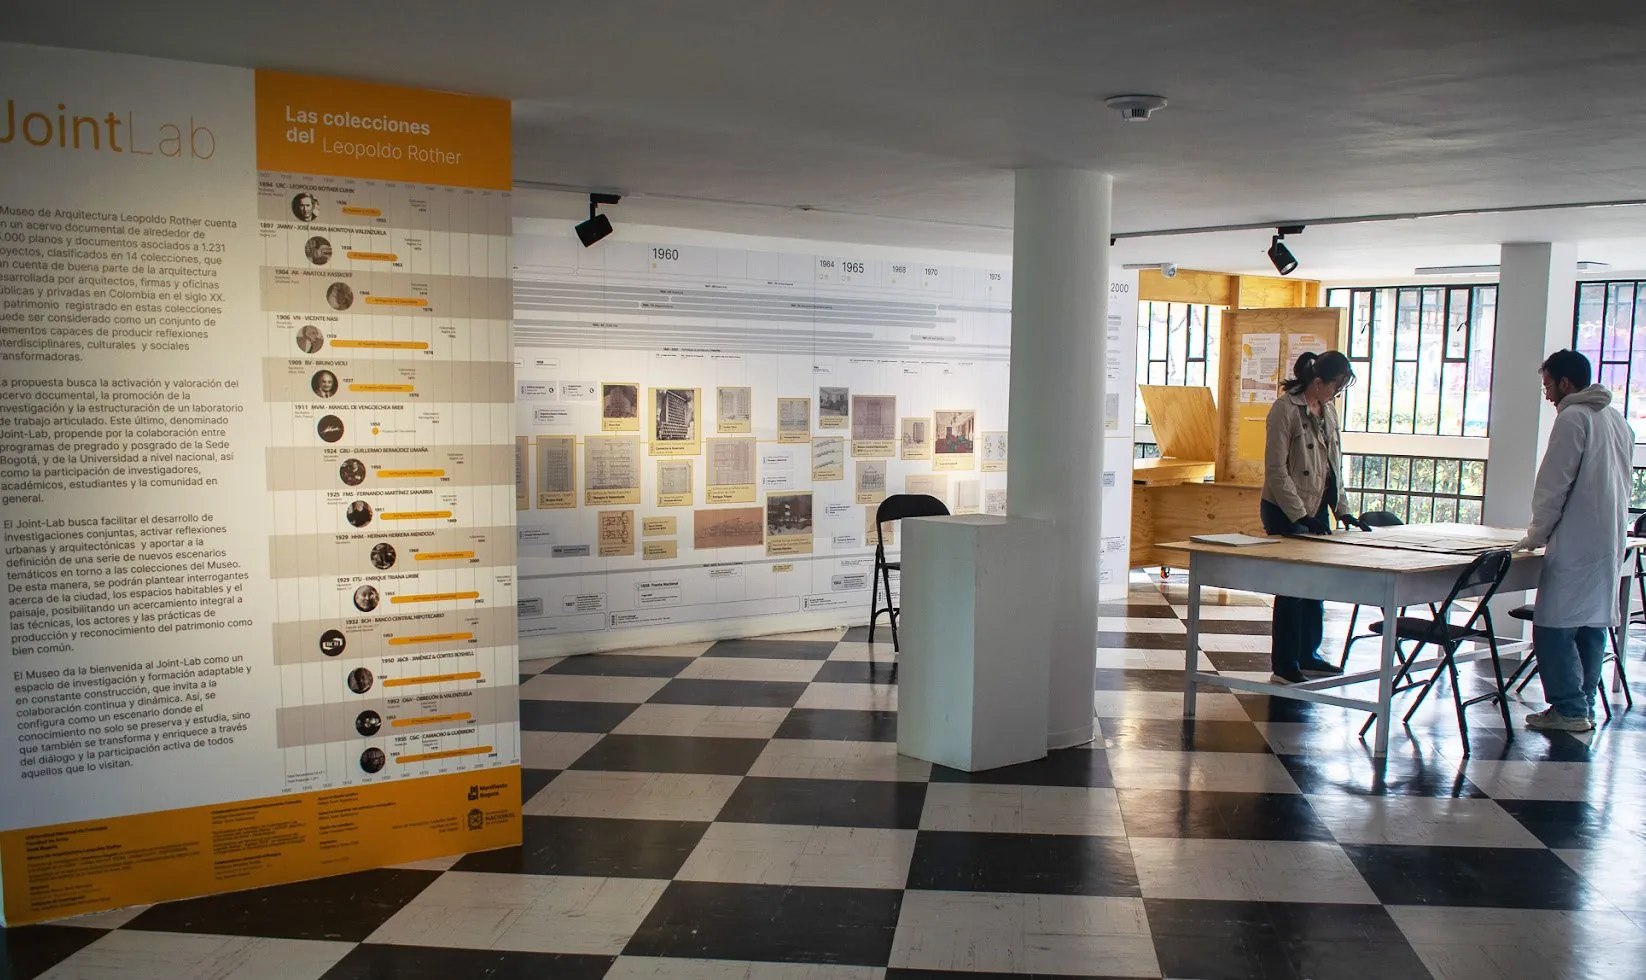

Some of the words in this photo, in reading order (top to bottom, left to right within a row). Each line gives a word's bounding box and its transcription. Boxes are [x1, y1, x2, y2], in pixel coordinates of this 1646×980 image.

[286, 105, 318, 124] Las
[323, 111, 430, 136] colecciones
[286, 127, 314, 144] del
[323, 137, 402, 160] Leopoldo
[408, 144, 462, 165] Rother
[0, 205, 34, 216] Museo
[37, 207, 51, 217] de
[54, 208, 118, 223] Arquitectura
[119, 212, 166, 225] Leopoldo
[169, 214, 201, 225] Rother
[204, 217, 237, 228] cuenta
[652, 248, 679, 261] 1960
[820, 260, 835, 268] 1964
[842, 262, 865, 274] 1965
[892, 265, 906, 274] 1968
[925, 268, 938, 276] 1970
[989, 273, 1001, 281] 1975
[1110, 282, 1129, 293] 2000
[53, 428, 102, 439] propende
[105, 430, 122, 439] por
[124, 428, 133, 437] la
[136, 427, 198, 436] colaboración
[200, 427, 226, 436] entre
[1, 454, 39, 466] Bogotá,
[43, 457, 49, 465] y
[51, 454, 65, 463] de
[67, 454, 77, 463] la
[79, 453, 139, 463] Universidad
[150, 452, 173, 462] nivel
[175, 452, 217, 462] nacional,
[220, 451, 234, 460] así
[31, 467, 42, 476] la
[43, 466, 110, 478] participación
[112, 466, 125, 475] de
[127, 465, 202, 477] investigadores,
[1, 479, 66, 491] académicos,
[68, 478, 127, 488] estudiantes
[130, 480, 136, 489] y
[138, 478, 147, 487] la
[149, 477, 203, 486] comunidad
[4, 519, 13, 528] El
[16, 517, 65, 527] Joint-Lab
[67, 516, 98, 525] busca
[101, 514, 137, 524] facilitar
[139, 514, 149, 523] el
[151, 512, 199, 523] desarrollo
[201, 512, 214, 521] de
[4, 529, 83, 543] investigaciones
[86, 527, 137, 540] conjuntas,
[140, 526, 172, 536] activar
[175, 524, 227, 535] reflexiones
[12, 644, 34, 655] bien
[36, 641, 74, 653] común.
[14, 670, 23, 679] El
[25, 667, 60, 678] Museo
[62, 666, 75, 676] da
[77, 665, 87, 674] la
[89, 661, 142, 673] bienvenida
[145, 660, 153, 669] al
[156, 656, 201, 668] Joint-Lab
[203, 656, 229, 665] como
[21, 765, 62, 780] aquellos
[65, 765, 84, 775] que
[86, 761, 96, 771] lo
[98, 758, 133, 770] visitan.
